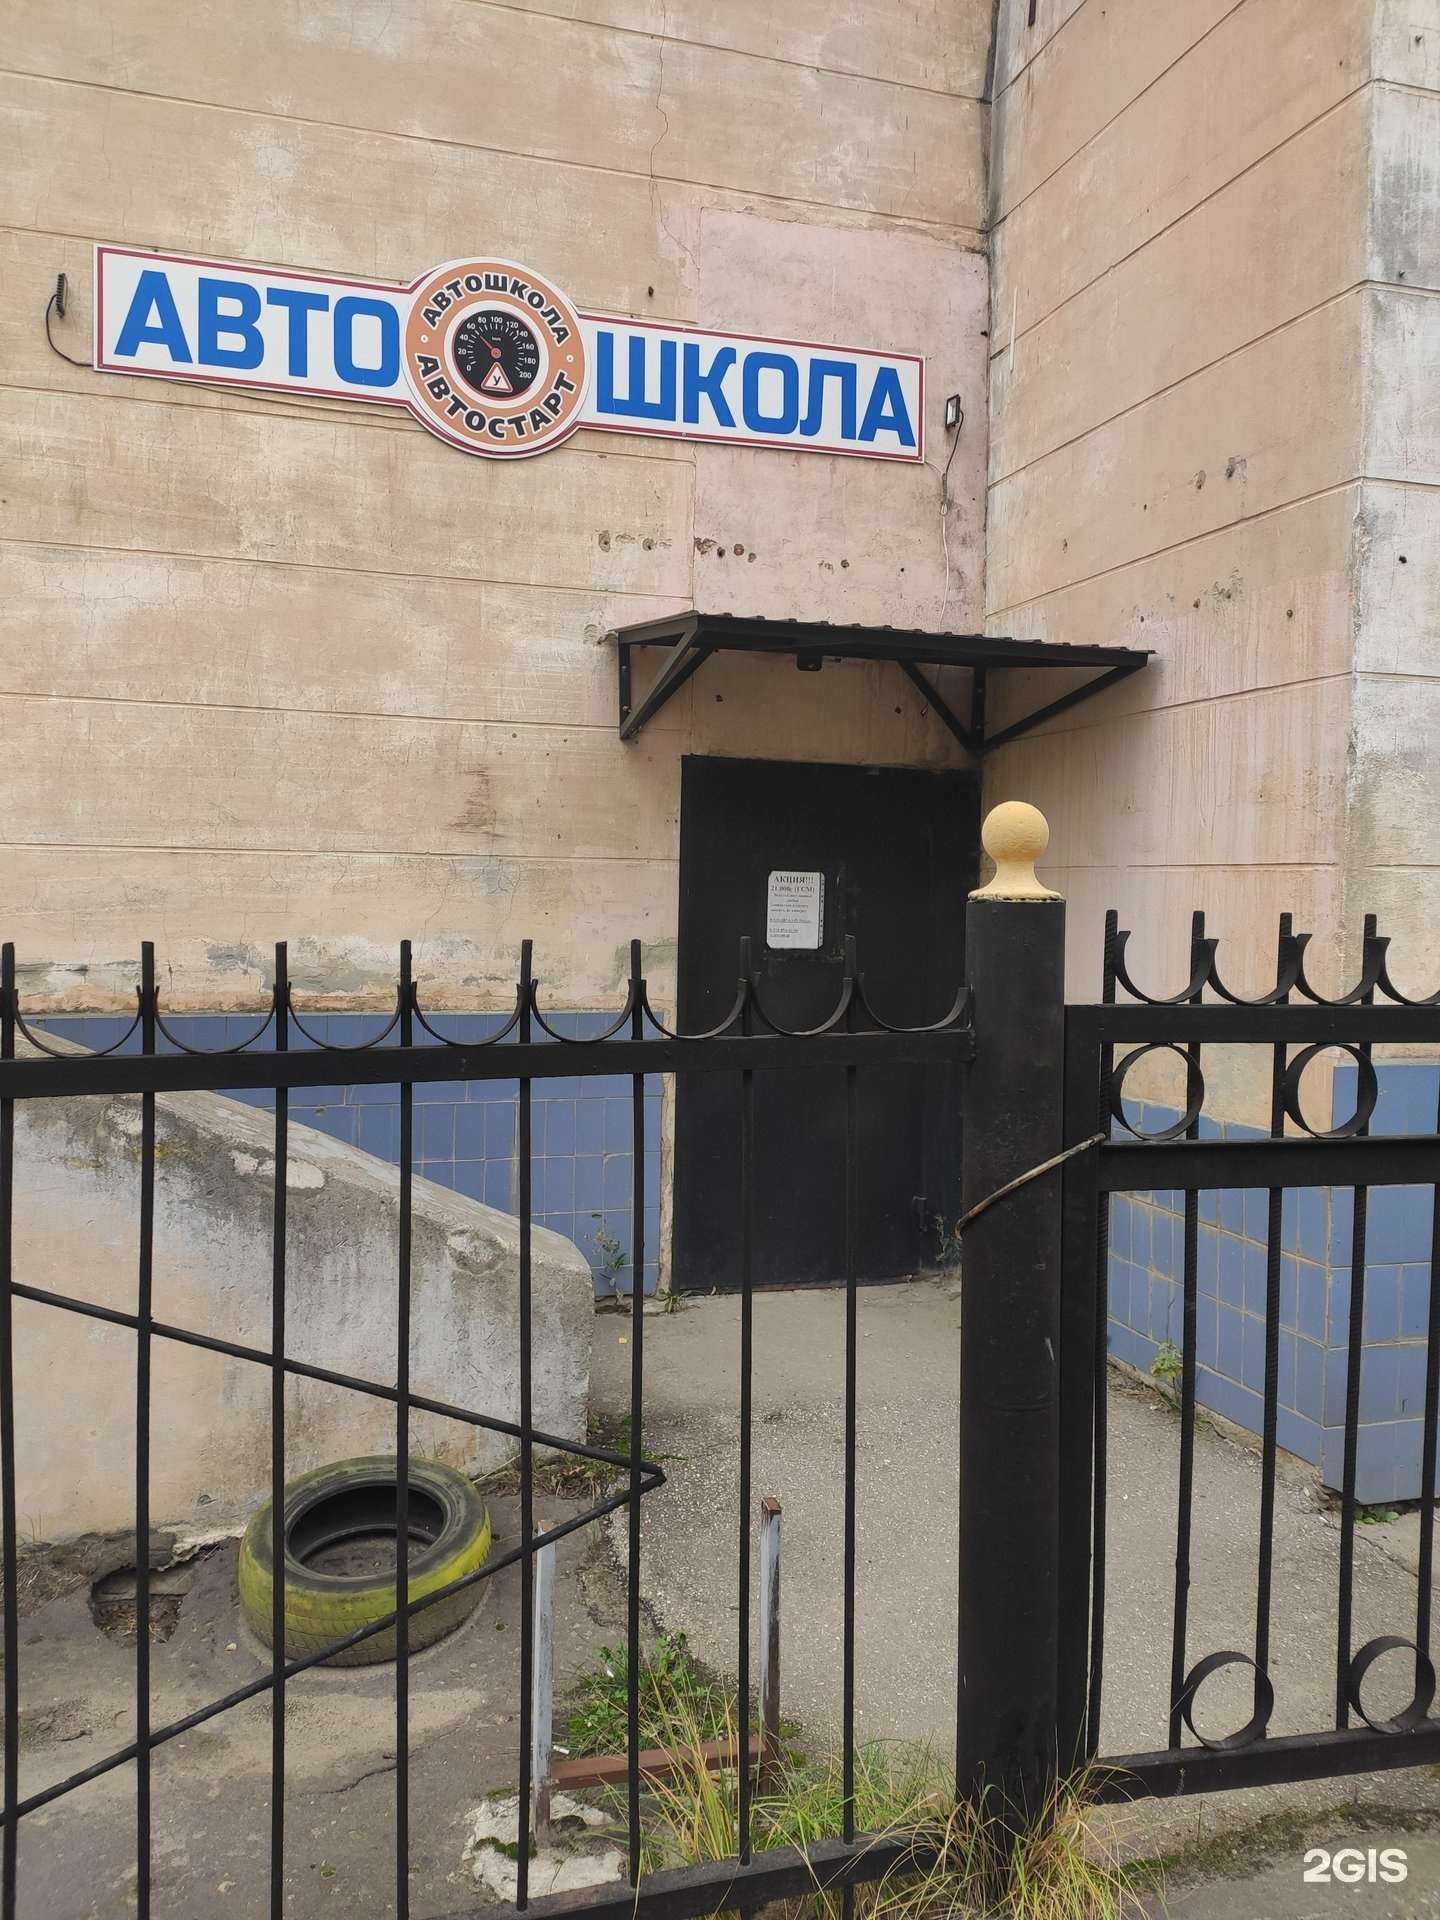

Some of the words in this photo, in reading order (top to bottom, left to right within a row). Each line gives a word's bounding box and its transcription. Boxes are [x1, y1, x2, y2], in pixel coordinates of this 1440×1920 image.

[422, 273, 570, 346] АВТОШКОЛА
[114, 270, 400, 388] АВТО
[595, 331, 916, 447] ШКОЛА
[416, 354, 576, 439] АВТОСТАРТ
